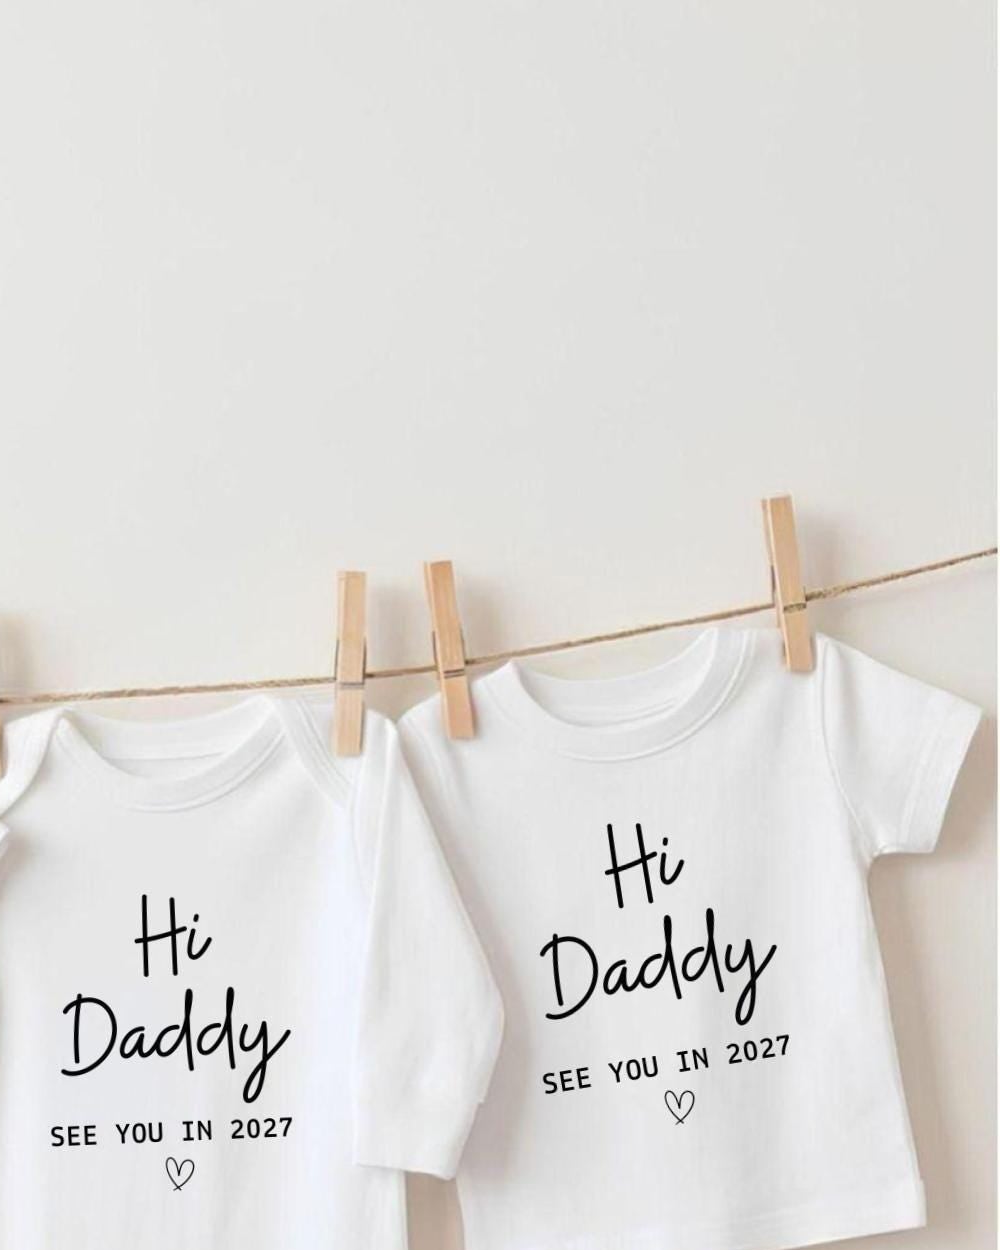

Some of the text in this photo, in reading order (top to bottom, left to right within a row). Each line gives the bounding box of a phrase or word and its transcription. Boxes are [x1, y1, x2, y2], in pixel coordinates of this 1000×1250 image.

[604, 822, 685, 909] Hi
[134, 894, 213, 978] Hi
[539, 907, 778, 1026] Daddy
[60, 986, 292, 1104] Daddy
[542, 1034, 791, 1095] SEE YOU IN 2027
[50, 1116, 293, 1147] SEE YOU IN 2027
